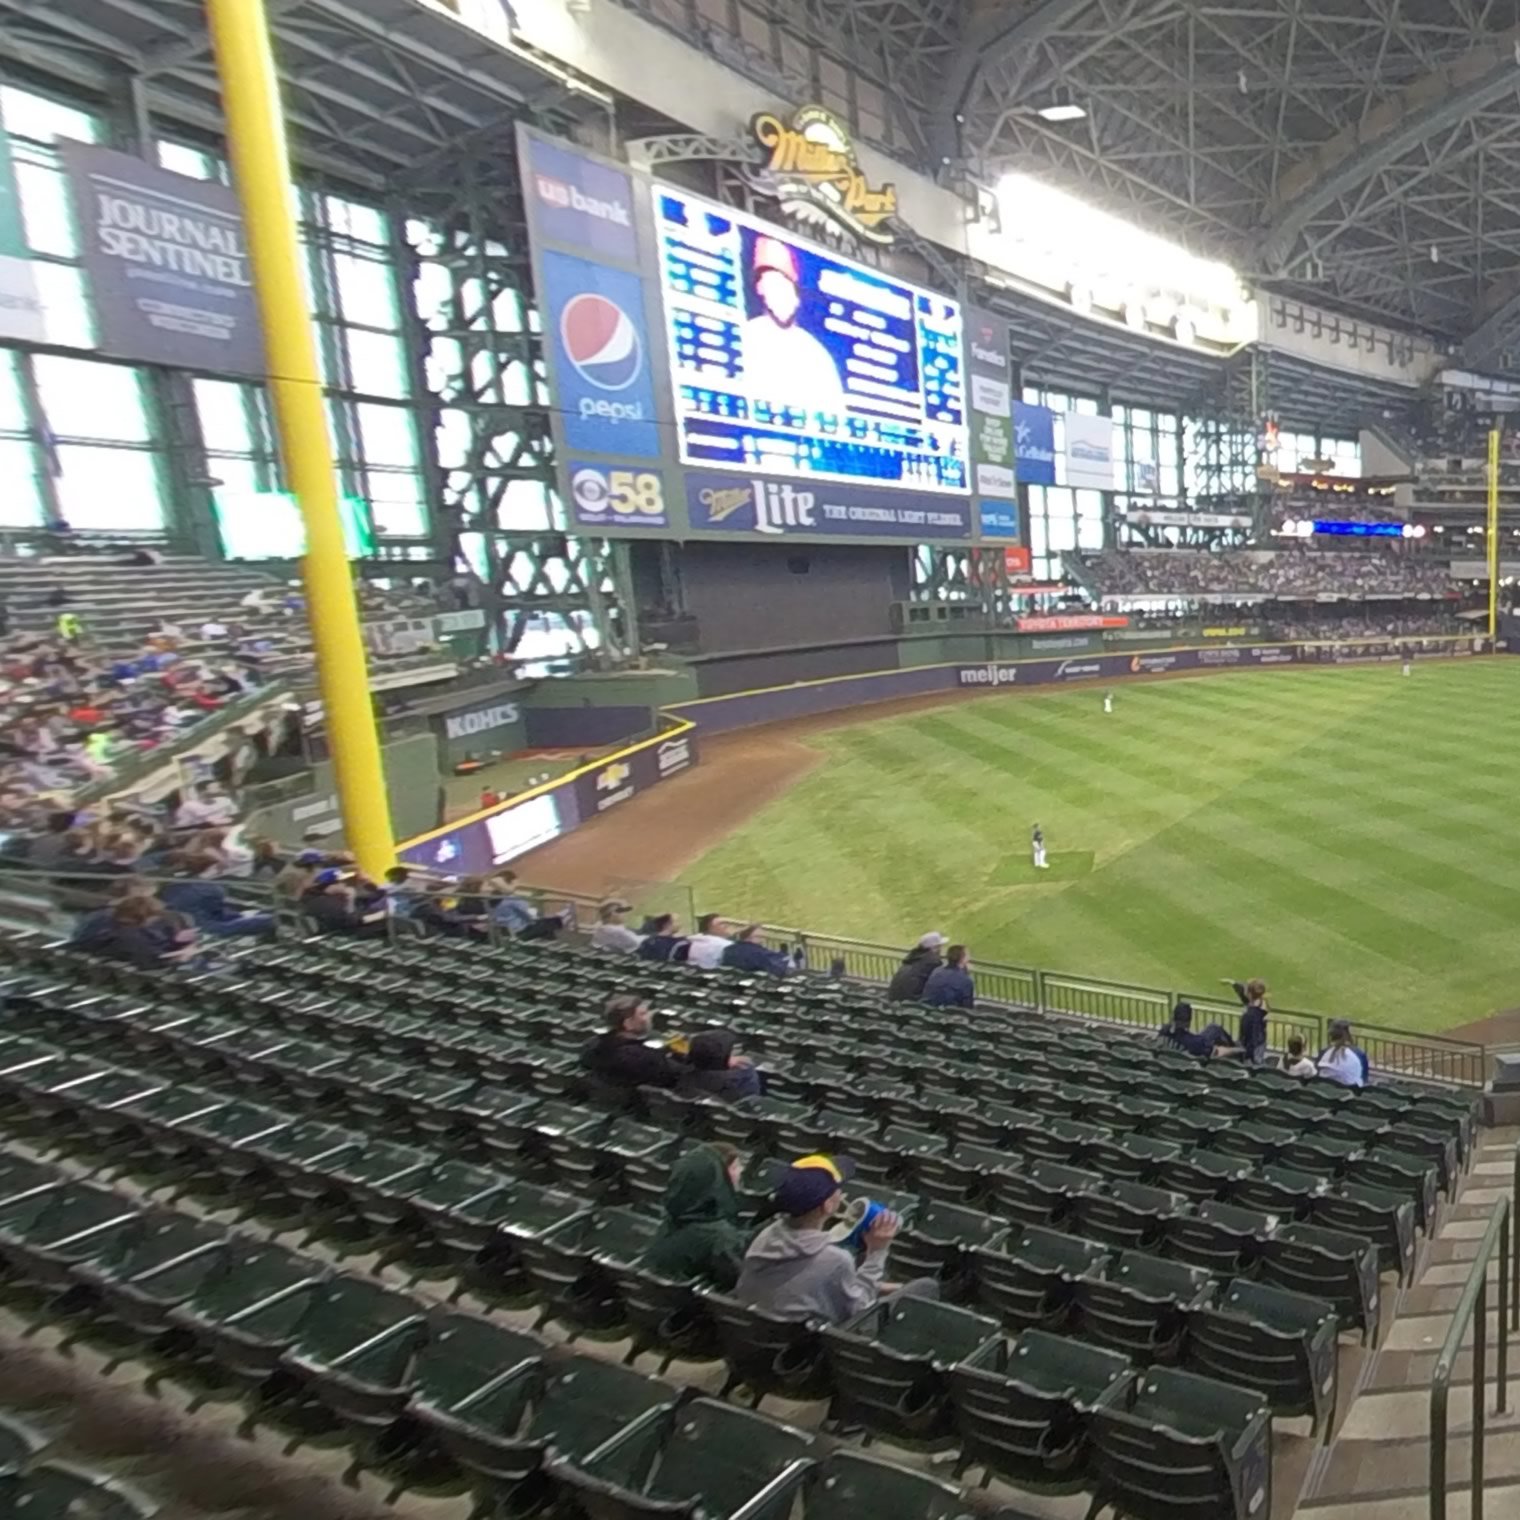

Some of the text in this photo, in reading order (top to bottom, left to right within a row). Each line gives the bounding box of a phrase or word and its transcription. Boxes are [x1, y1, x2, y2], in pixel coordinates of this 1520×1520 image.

[97, 194, 247, 258] JOURNAL
[98, 227, 251, 287] SENTINEL
[579, 397, 643, 424] pepsi
[610, 470, 664, 515] 58
[960, 664, 1016, 686] meijer
